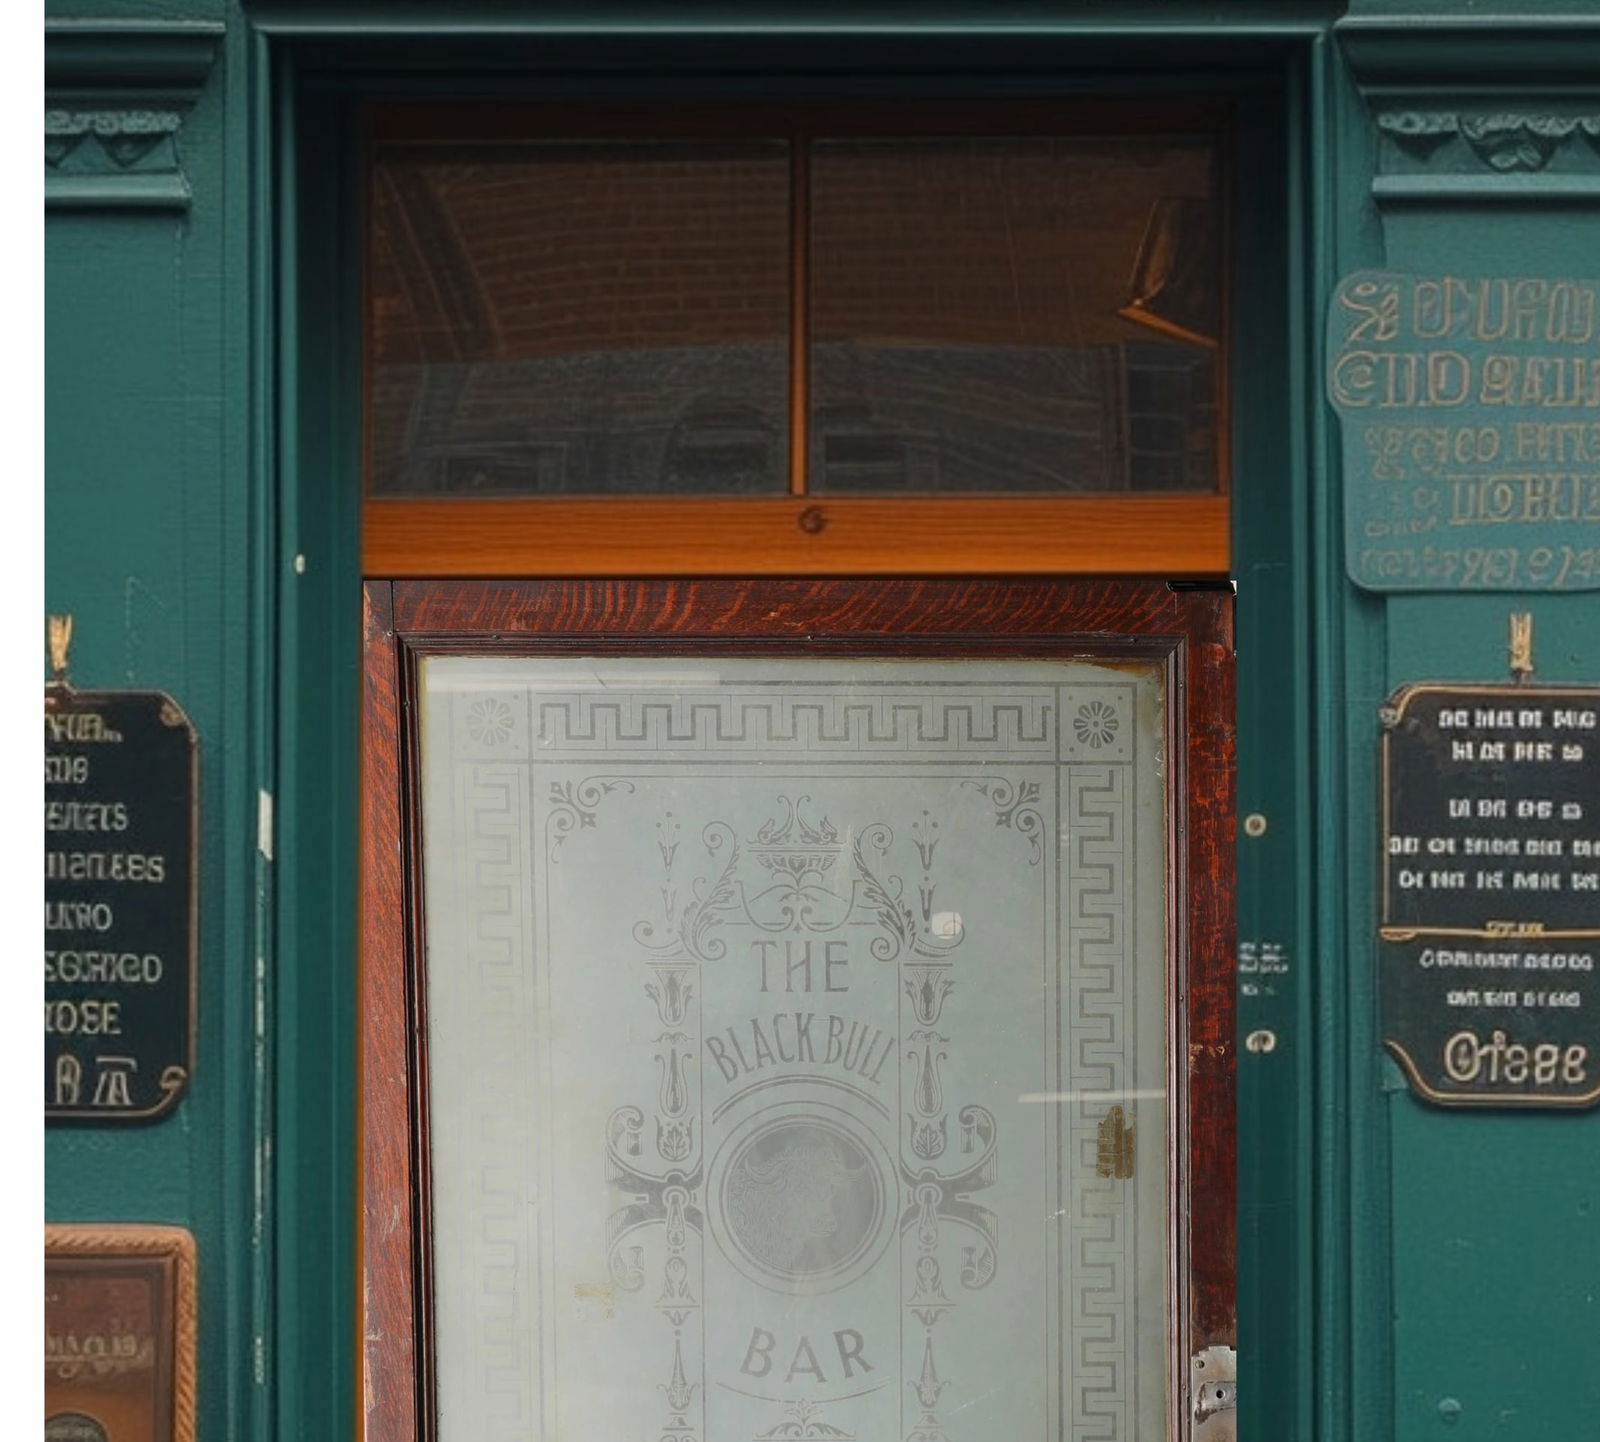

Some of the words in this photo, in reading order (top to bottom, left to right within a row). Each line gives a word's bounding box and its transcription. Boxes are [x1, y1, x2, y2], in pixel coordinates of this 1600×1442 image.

[751, 940, 849, 992] THE
[705, 1012, 816, 1084] BLACK
[823, 1014, 896, 1085] BULL
[739, 1326, 875, 1383] BAR
